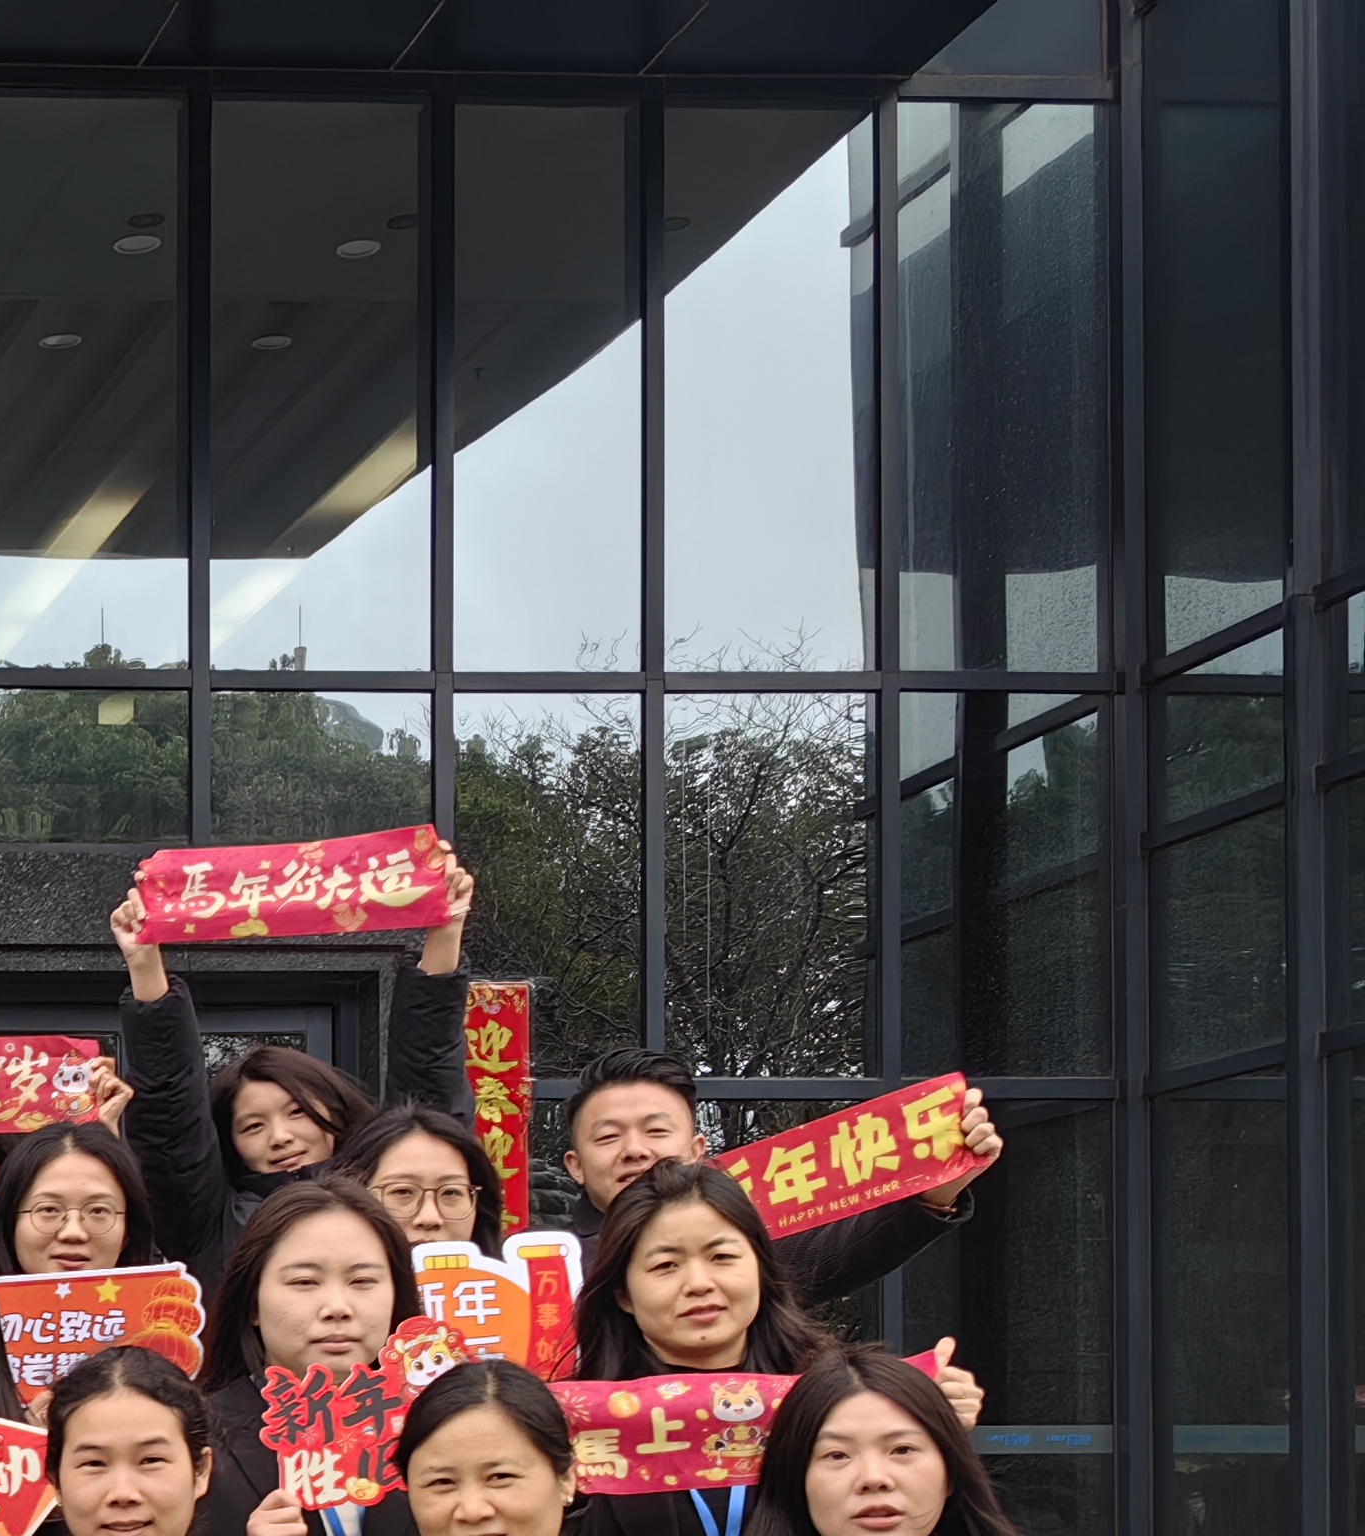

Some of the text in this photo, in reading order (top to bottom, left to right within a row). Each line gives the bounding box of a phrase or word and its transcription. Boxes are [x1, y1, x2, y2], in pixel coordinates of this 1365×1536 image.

[779, 1181, 900, 1227] HAPPY NEW YEAR
[271, 1371, 402, 1446] 新年
[573, 1407, 691, 1478] 馬上
